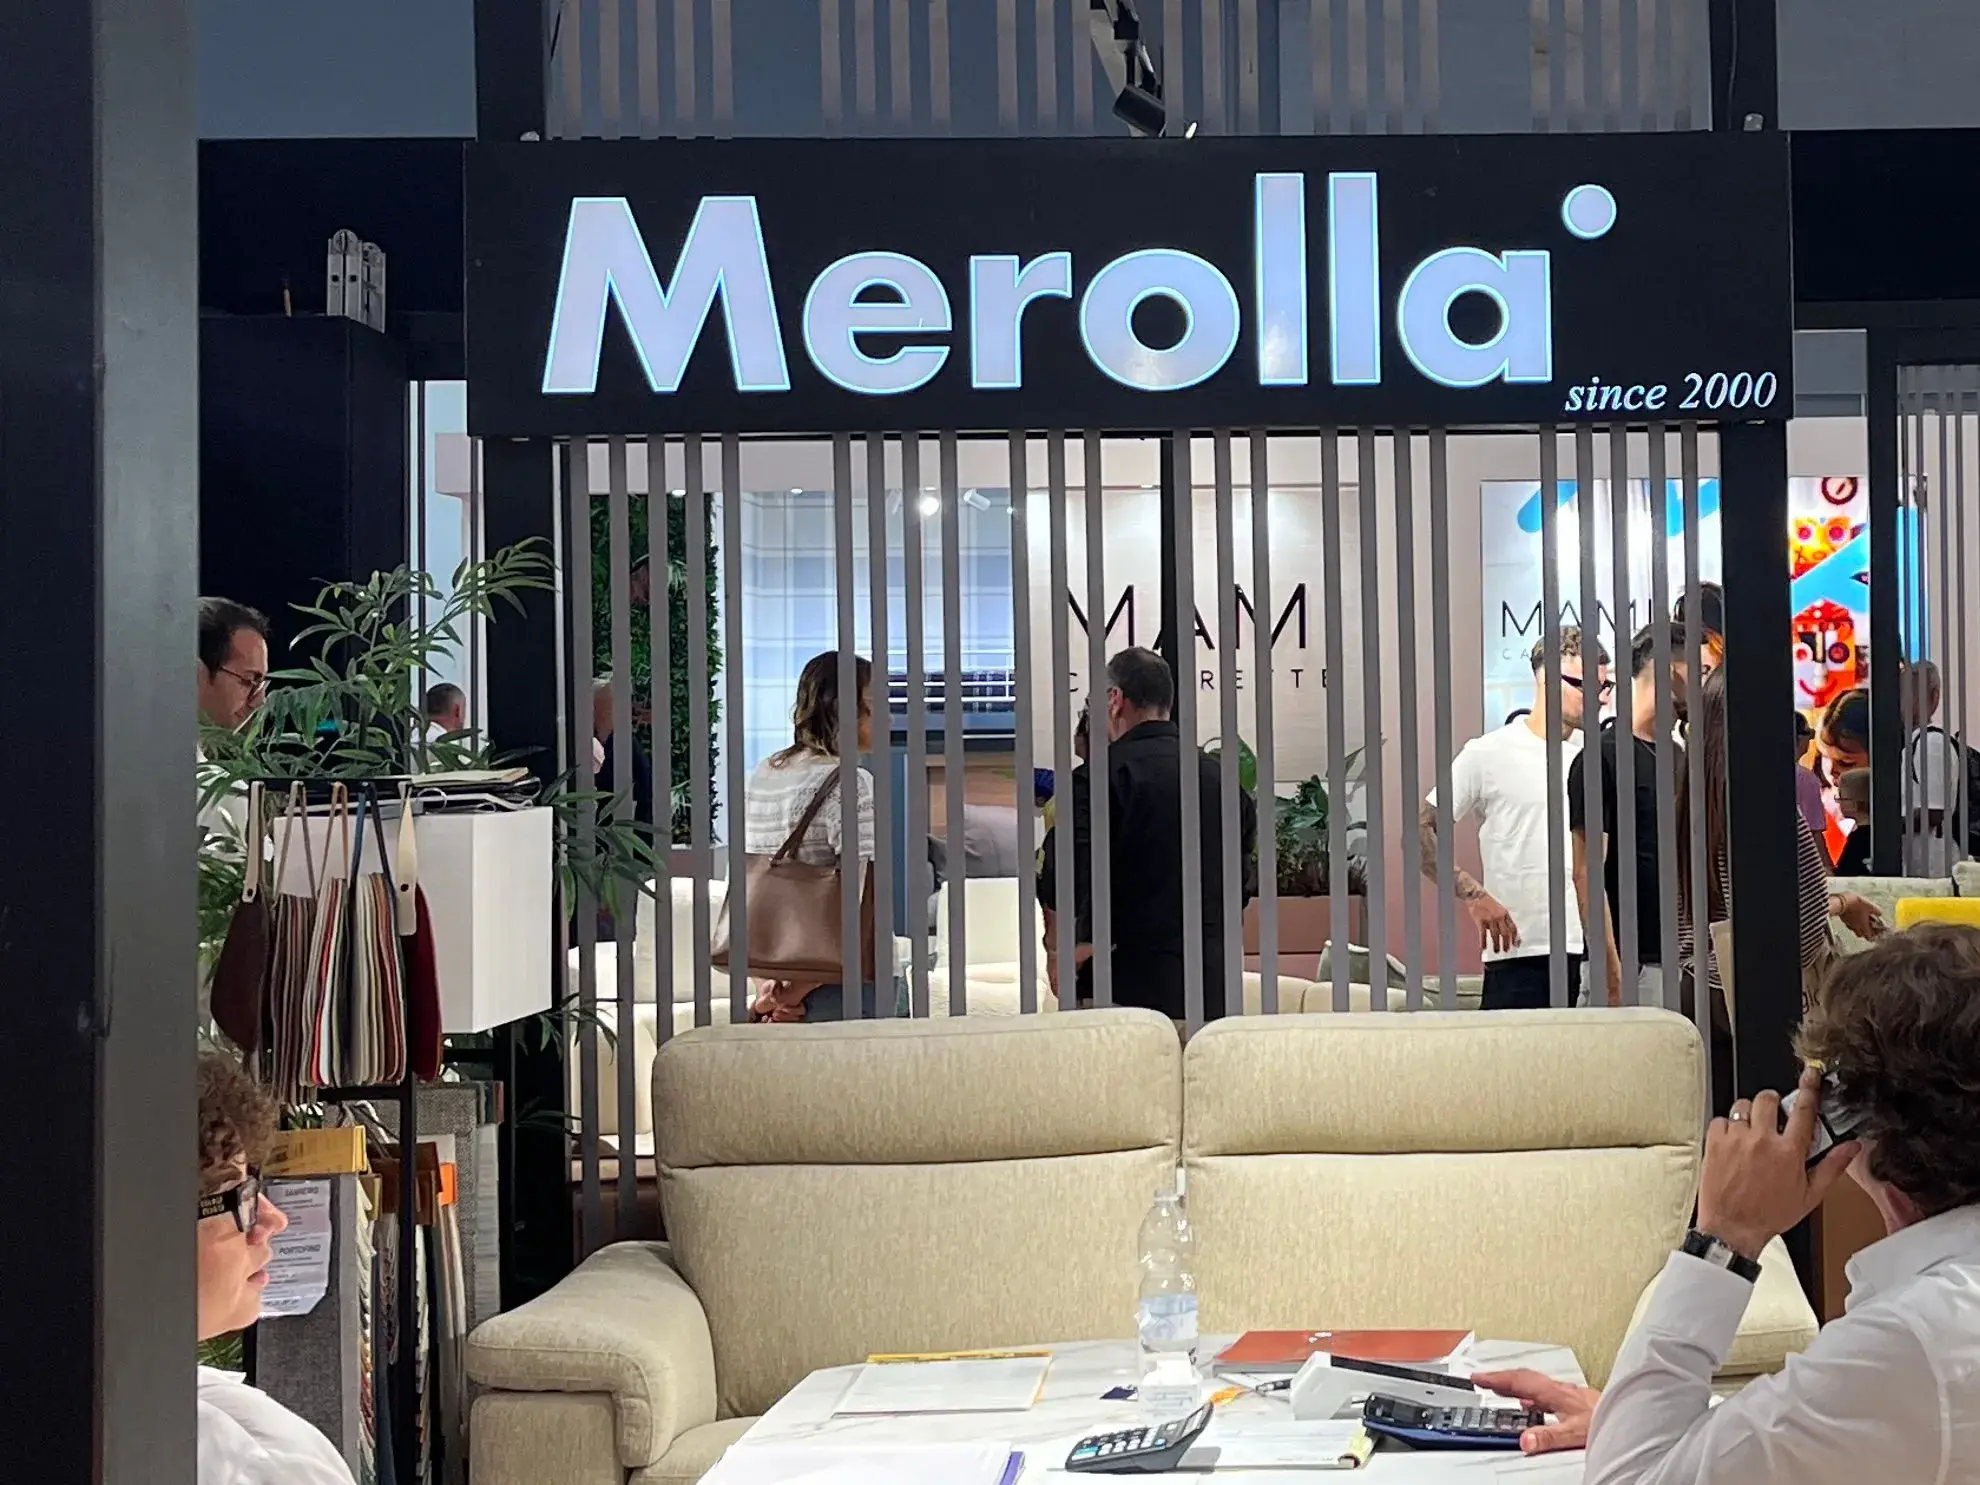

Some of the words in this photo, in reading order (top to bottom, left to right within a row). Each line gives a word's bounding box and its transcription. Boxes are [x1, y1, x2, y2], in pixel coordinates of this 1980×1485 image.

[541, 171, 1554, 394] Merolla
[1564, 376, 1668, 412] since
[1679, 371, 1778, 410] 2000
